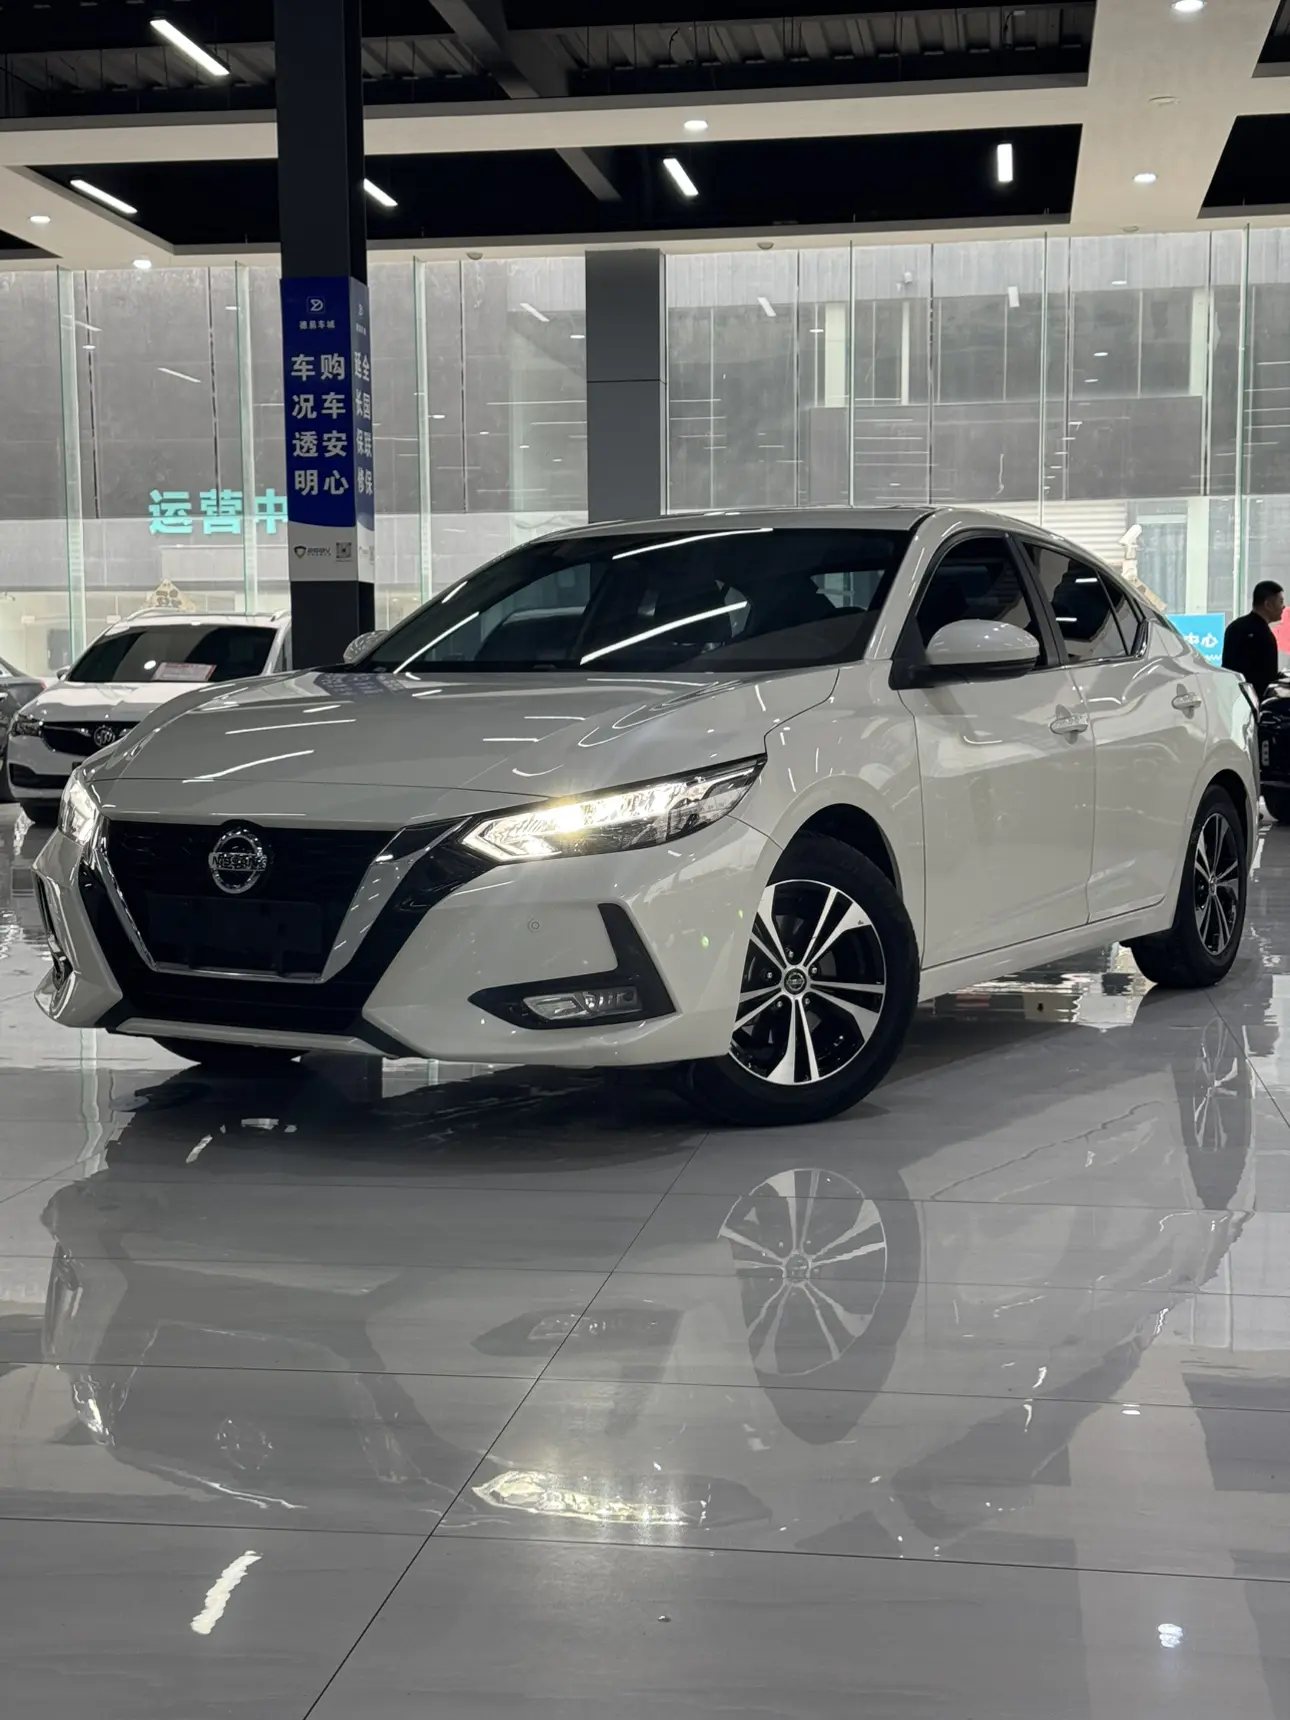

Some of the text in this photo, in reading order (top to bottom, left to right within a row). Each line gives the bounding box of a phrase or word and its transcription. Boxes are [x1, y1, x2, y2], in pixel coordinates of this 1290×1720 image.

[291, 354, 319, 496] 车况透明
[320, 353, 349, 495] 购车安心
[148, 488, 288, 535] 运营中
